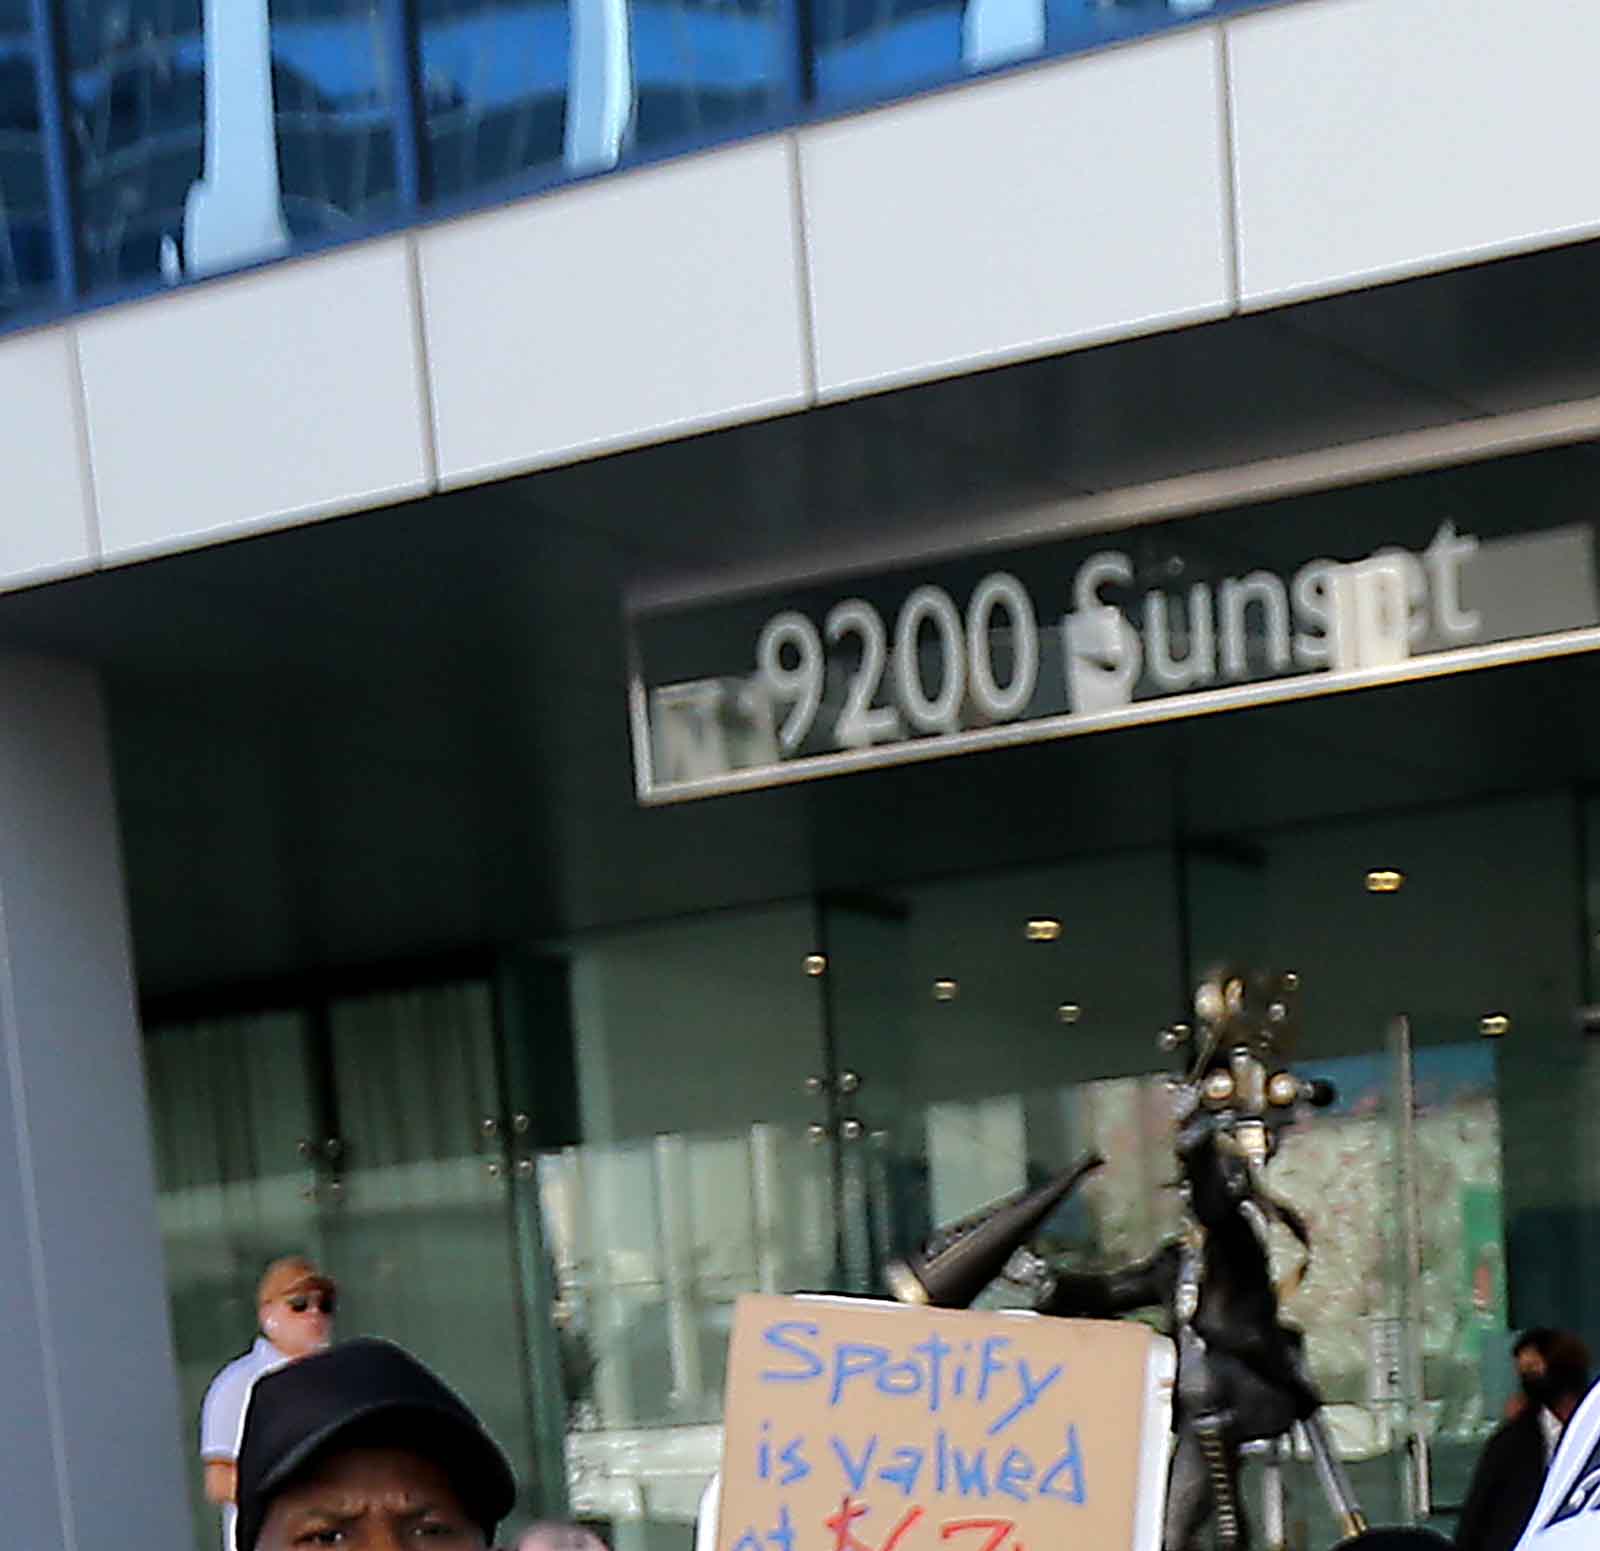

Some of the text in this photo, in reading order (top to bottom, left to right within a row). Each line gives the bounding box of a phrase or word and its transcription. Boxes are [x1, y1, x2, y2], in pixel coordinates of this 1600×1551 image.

[757, 517, 1482, 752] 9200 Sunset
[757, 1421, 1087, 1505] is valued
